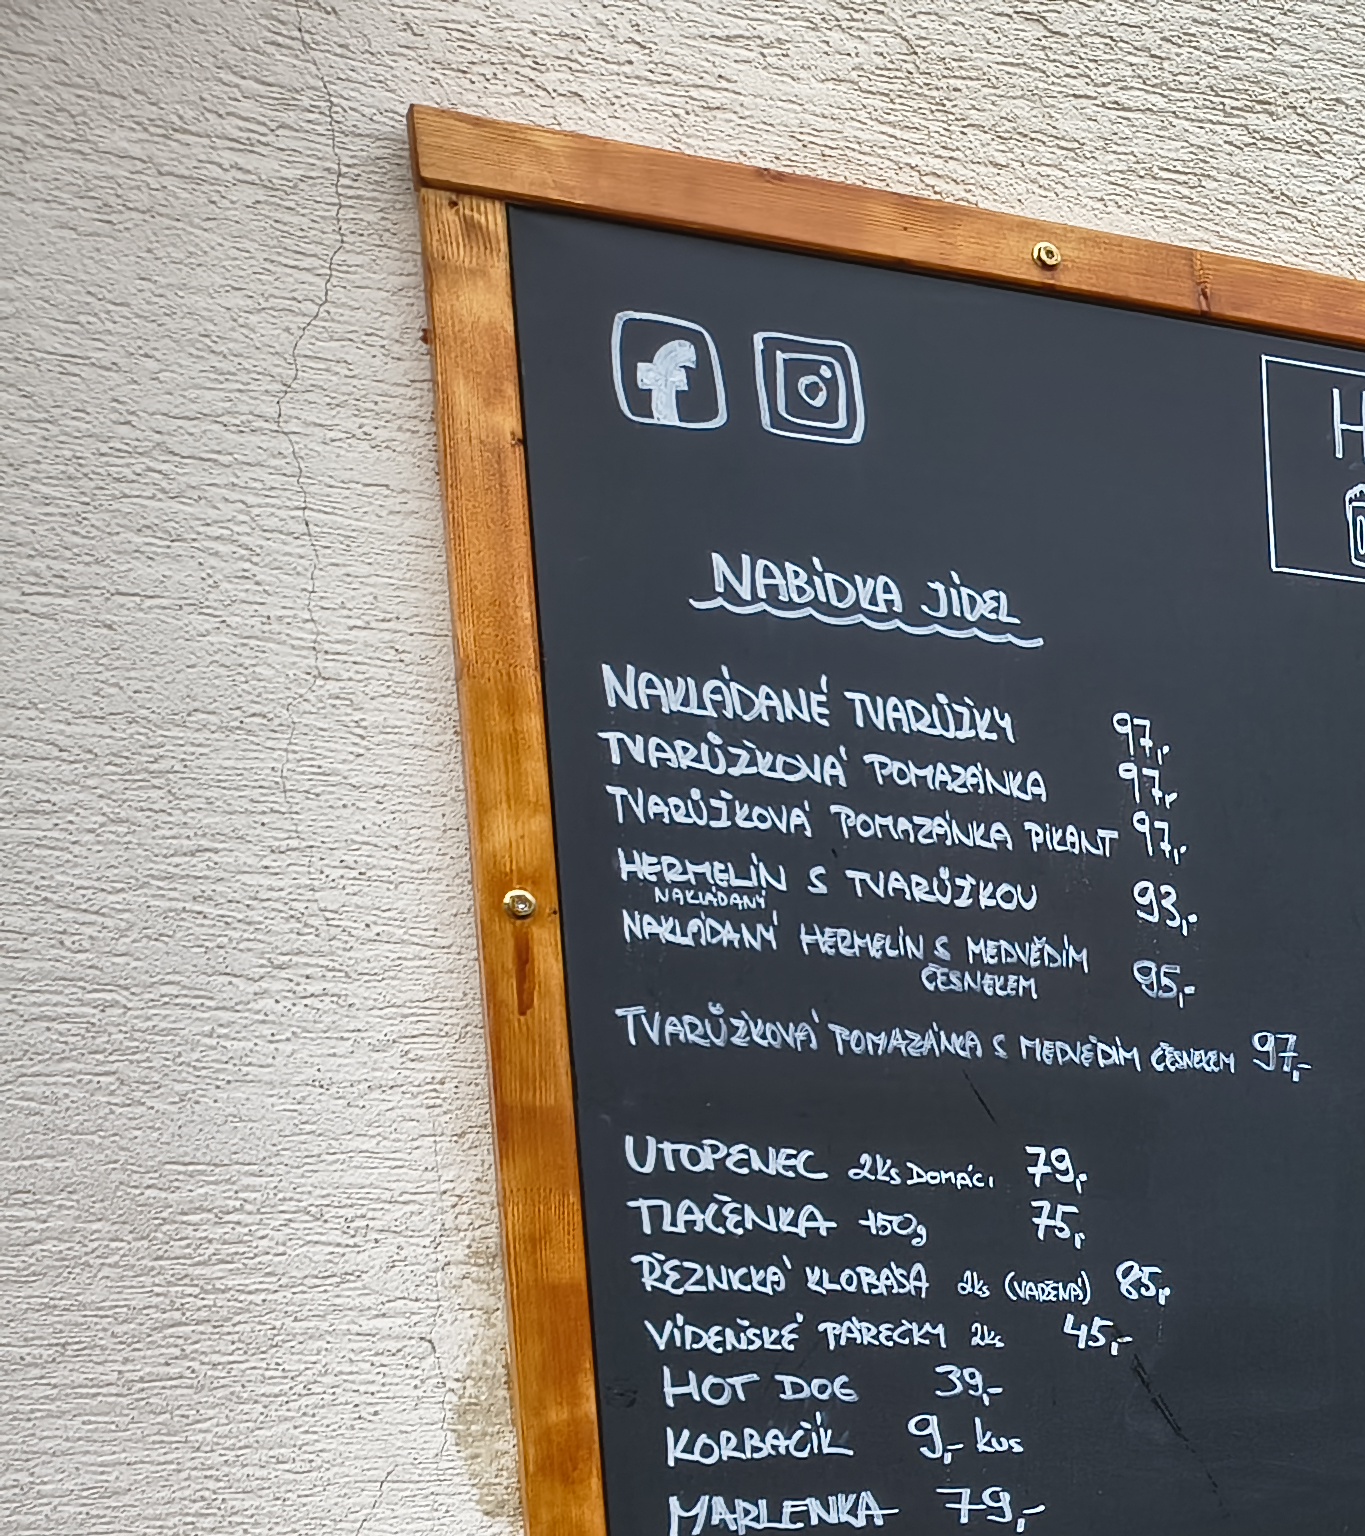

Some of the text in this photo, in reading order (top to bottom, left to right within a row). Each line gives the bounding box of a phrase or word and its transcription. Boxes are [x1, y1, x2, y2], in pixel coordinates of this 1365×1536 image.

[711, 551, 1021, 625] NABÍDKA JÍDEL
[601, 663, 830, 727] NAKLÁDANÉ
[844, 691, 1015, 743] TVARŮŽKY
[598, 732, 848, 787] TVARŮŽKOVÁ
[863, 753, 1047, 802] POMAZÁNKA
[606, 784, 813, 837] TVARŮŽKOVÁ
[830, 804, 1014, 851] POMAZÁNKA
[1024, 820, 1118, 857] PIKANT
[617, 847, 787, 891] HERMELÍN
[845, 866, 1038, 911] TVARŮŽKOU
[622, 909, 778, 951] NAKLÁDANÝ
[801, 923, 924, 960] HERMELÍN
[967, 934, 1088, 973] MEDVĚDÍM
[1132, 959, 1195, 1008] 95,-
[921, 962, 1037, 1000] ČESNEKEM
[615, 1002, 818, 1051] TVARŮŽKOVÁ
[828, 1021, 982, 1059] POMAZÁNKA
[1020, 1034, 1141, 1072] MEDVĚDÍM
[1150, 1041, 1236, 1074] ČESNEKEM
[1252, 1031, 1312, 1082] 97,-
[624, 1134, 829, 1181] UTOPENEC
[626, 1194, 837, 1237] TLAČENKA
[630, 1252, 793, 1294] ŘEZNICKÁ
[806, 1261, 930, 1299] KLOBÁSA
[643, 1313, 804, 1353] VÍDEŇSKÉ
[818, 1315, 948, 1350] PÁREČKY
[1062, 1313, 1133, 1356] 45,-
[662, 1363, 1004, 1407] HOT DOG 39,-
[666, 1411, 854, 1467] KORBAČÍK
[974, 1416, 1025, 1455] kus
[936, 1485, 1047, 1533] 79,-
